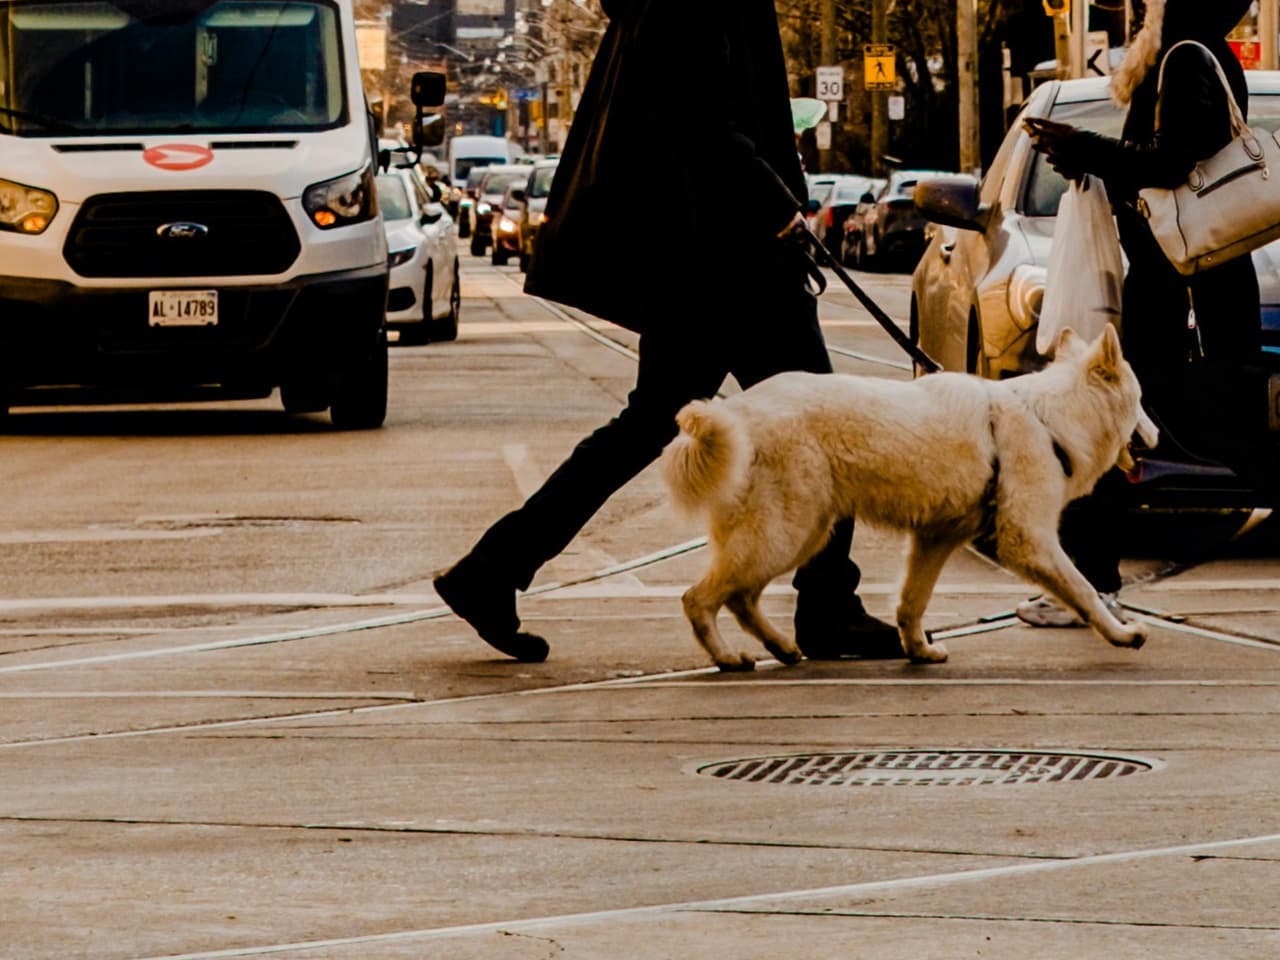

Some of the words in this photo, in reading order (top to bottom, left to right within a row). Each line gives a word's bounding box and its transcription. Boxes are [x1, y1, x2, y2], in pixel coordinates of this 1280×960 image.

[820, 82, 839, 95] 30
[153, 300, 166, 317] AL
[177, 300, 215, 317] 14789
